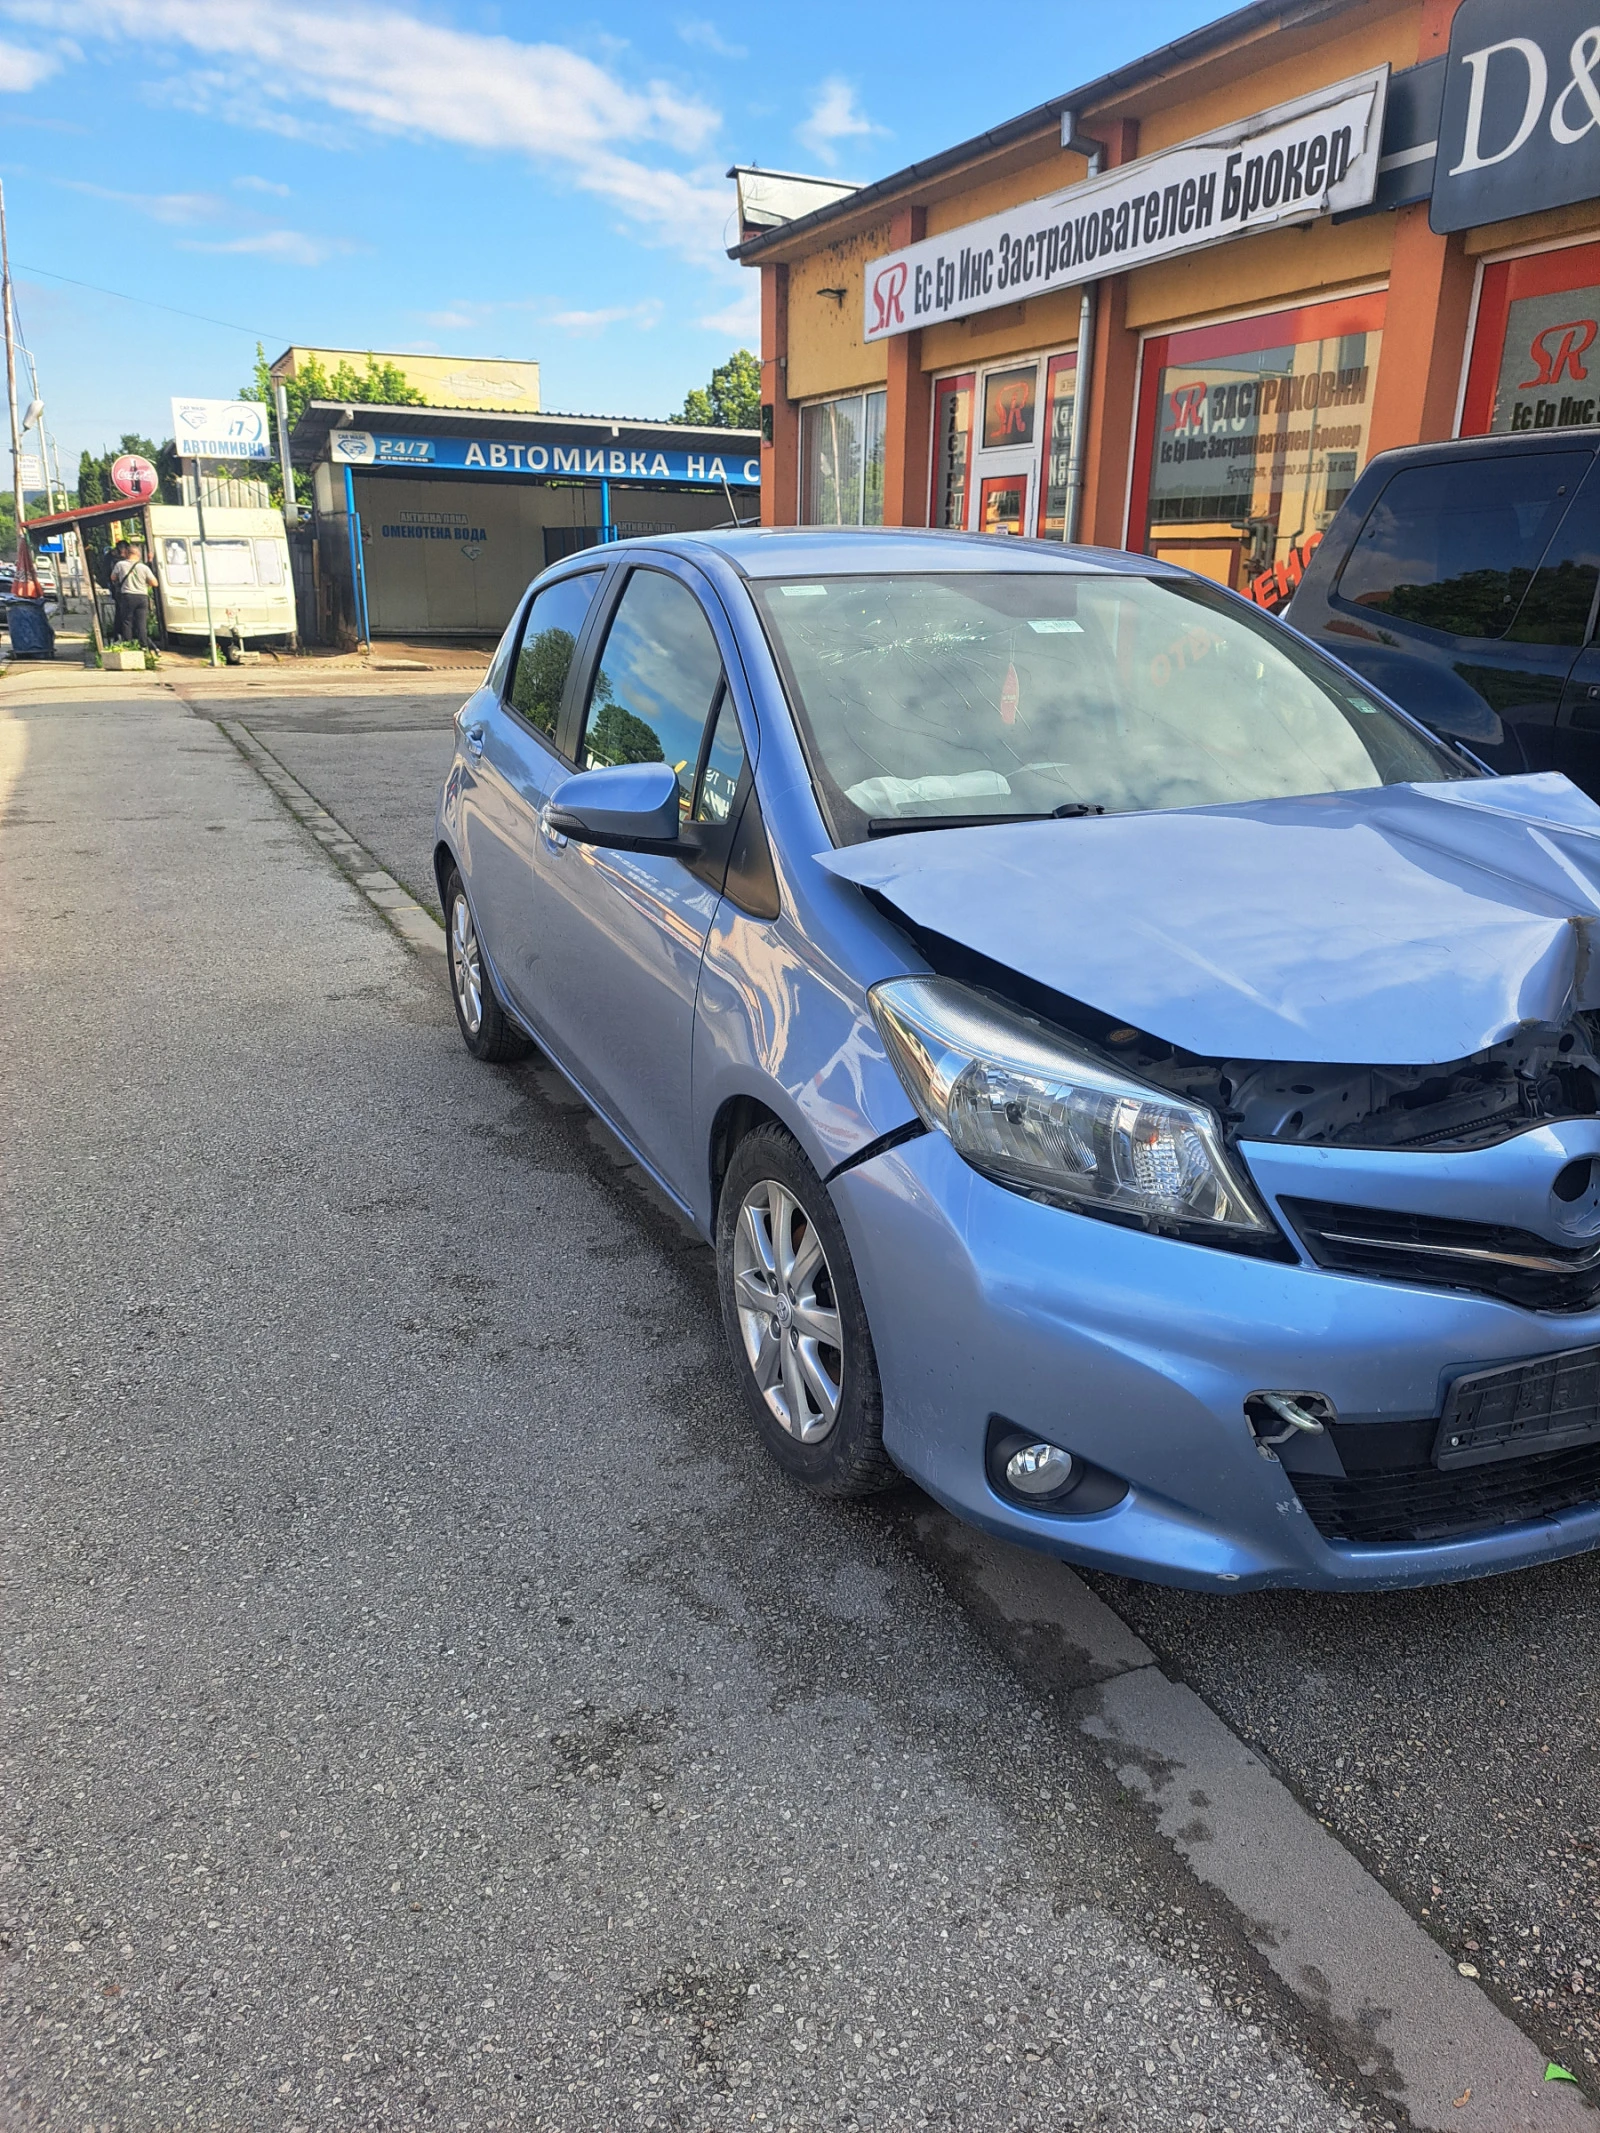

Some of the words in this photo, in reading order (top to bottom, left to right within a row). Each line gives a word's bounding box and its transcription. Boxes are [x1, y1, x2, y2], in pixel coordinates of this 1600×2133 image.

[914, 264, 932, 315] Ес
[936, 256, 955, 312] Ер
[959, 247, 994, 301] Инс
[998, 171, 1217, 290] Застрахователен
[1220, 125, 1352, 222] Брокер
[1212, 366, 1369, 421] ЗАСТРАХОВКИ
[1511, 402, 1533, 432] Ес
[1558, 396, 1596, 427] Инс
[183, 439, 266, 457] АВТОМИВКА
[380, 440, 429, 456] 24/7
[464, 443, 670, 477] АВТОМИВКА
[687, 455, 728, 480] НА
[382, 524, 452, 540] ОМЕКОТЕНА
[454, 527, 487, 543] ВОДА
